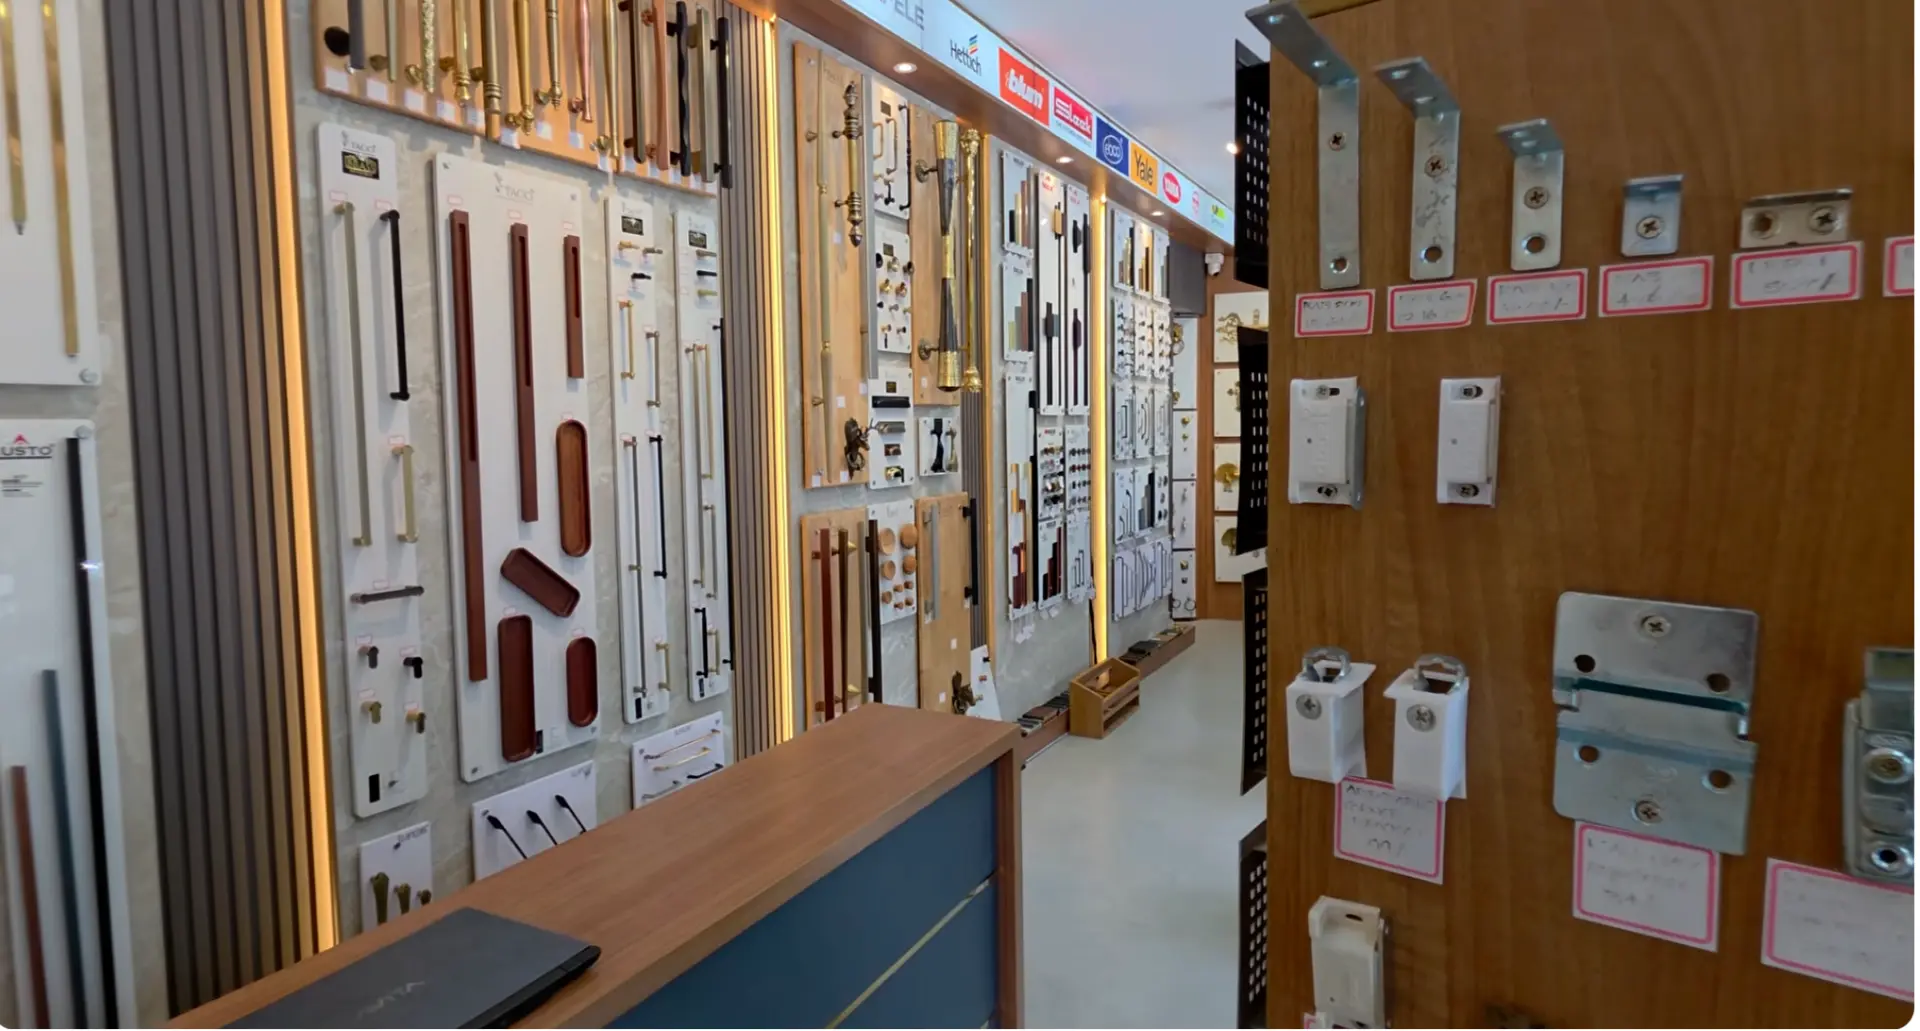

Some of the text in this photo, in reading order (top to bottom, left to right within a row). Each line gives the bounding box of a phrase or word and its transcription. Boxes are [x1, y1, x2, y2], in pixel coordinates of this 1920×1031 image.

[949, 39, 982, 76] Hettich
[1008, 68, 1043, 110] blum
[1134, 149, 1154, 186] Yale
